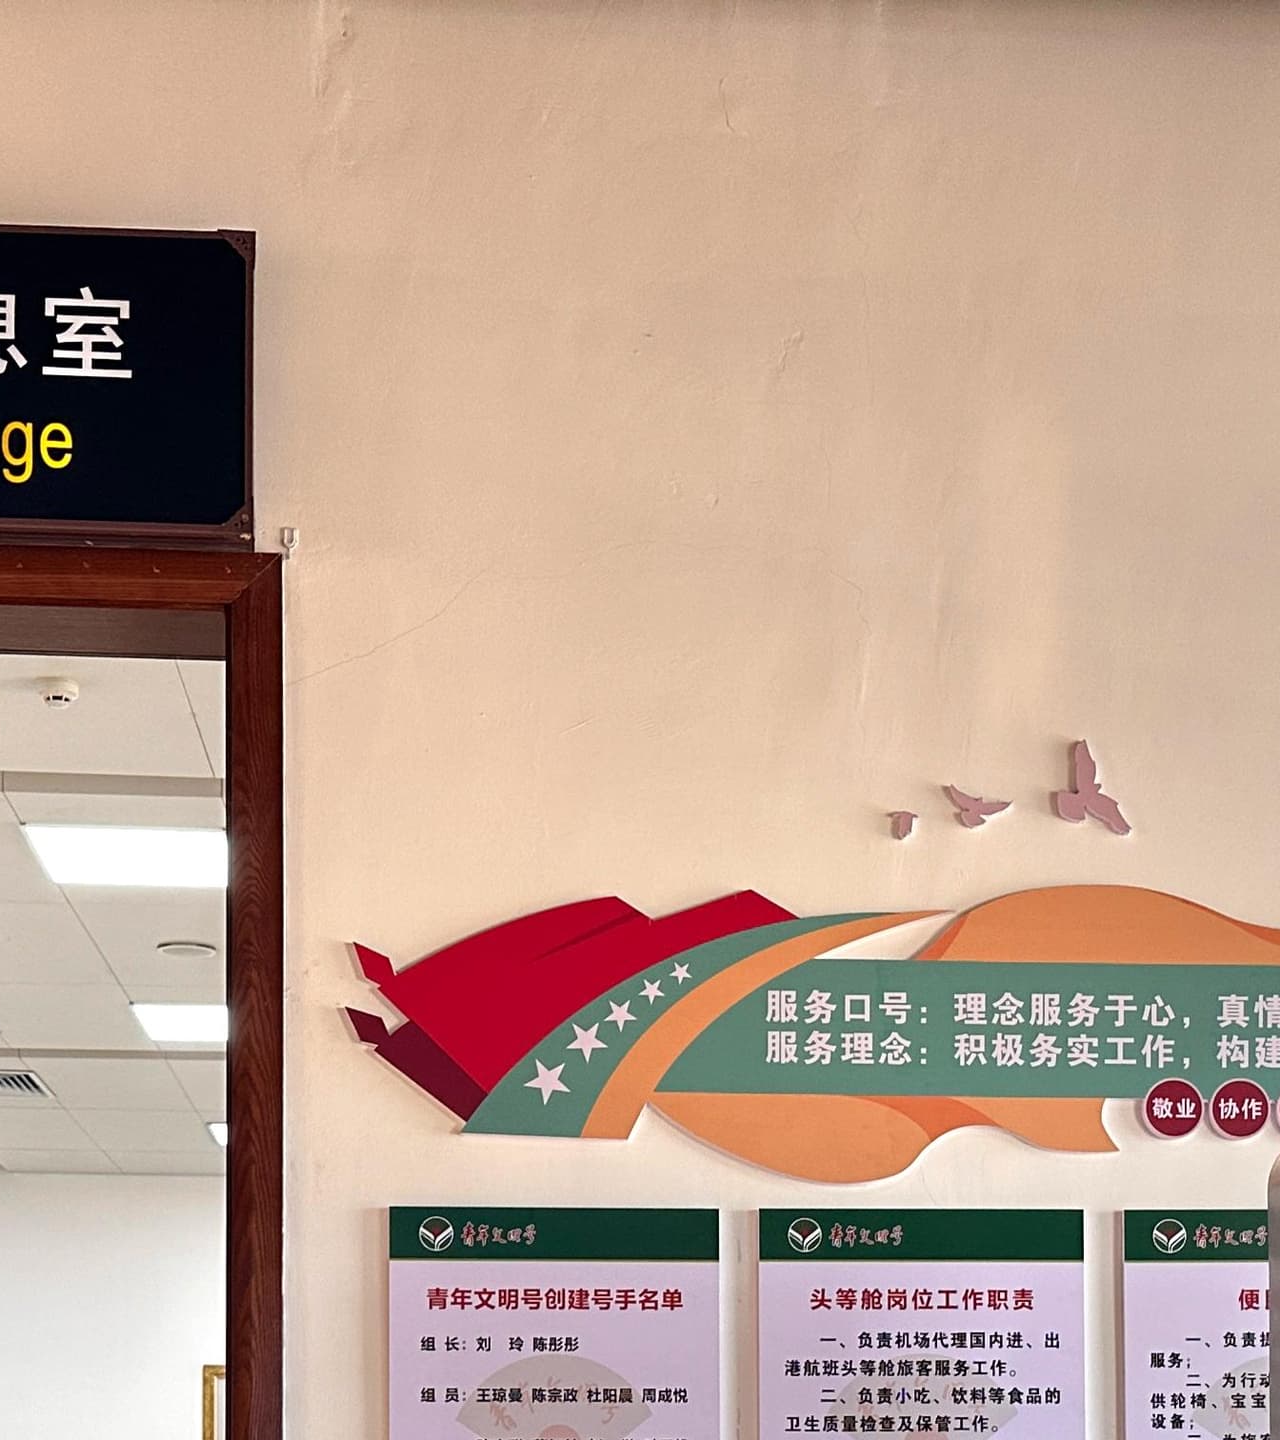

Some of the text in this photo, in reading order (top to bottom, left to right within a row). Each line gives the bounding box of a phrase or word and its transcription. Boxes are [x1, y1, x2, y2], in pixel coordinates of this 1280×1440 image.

[1151, 1098, 1196, 1119] 敬业
[1218, 1099, 1262, 1120] 协作
[427, 1288, 683, 1310] 青年文明号创建号手名单
[810, 1288, 1034, 1310] 头等舱岗位工作职责
[533, 1337, 579, 1352] 陈彤彤
[820, 1333, 1060, 1349] 一、负责机场代理国内进、出
[784, 1360, 1018, 1377] 港航班头等舱旅客服务工作。
[476, 1388, 523, 1403] 王琼曼
[532, 1388, 578, 1403] 陈宗政
[587, 1388, 633, 1403] 杜阳晨
[642, 1388, 689, 1403] 周成悦
[821, 1388, 1061, 1405] 二、负责小吃、饮料等食品的
[1150, 1393, 1266, 1409] 供轮椅、宝宝
[785, 1416, 1000, 1433] 卫生质量检查及保管工作。
